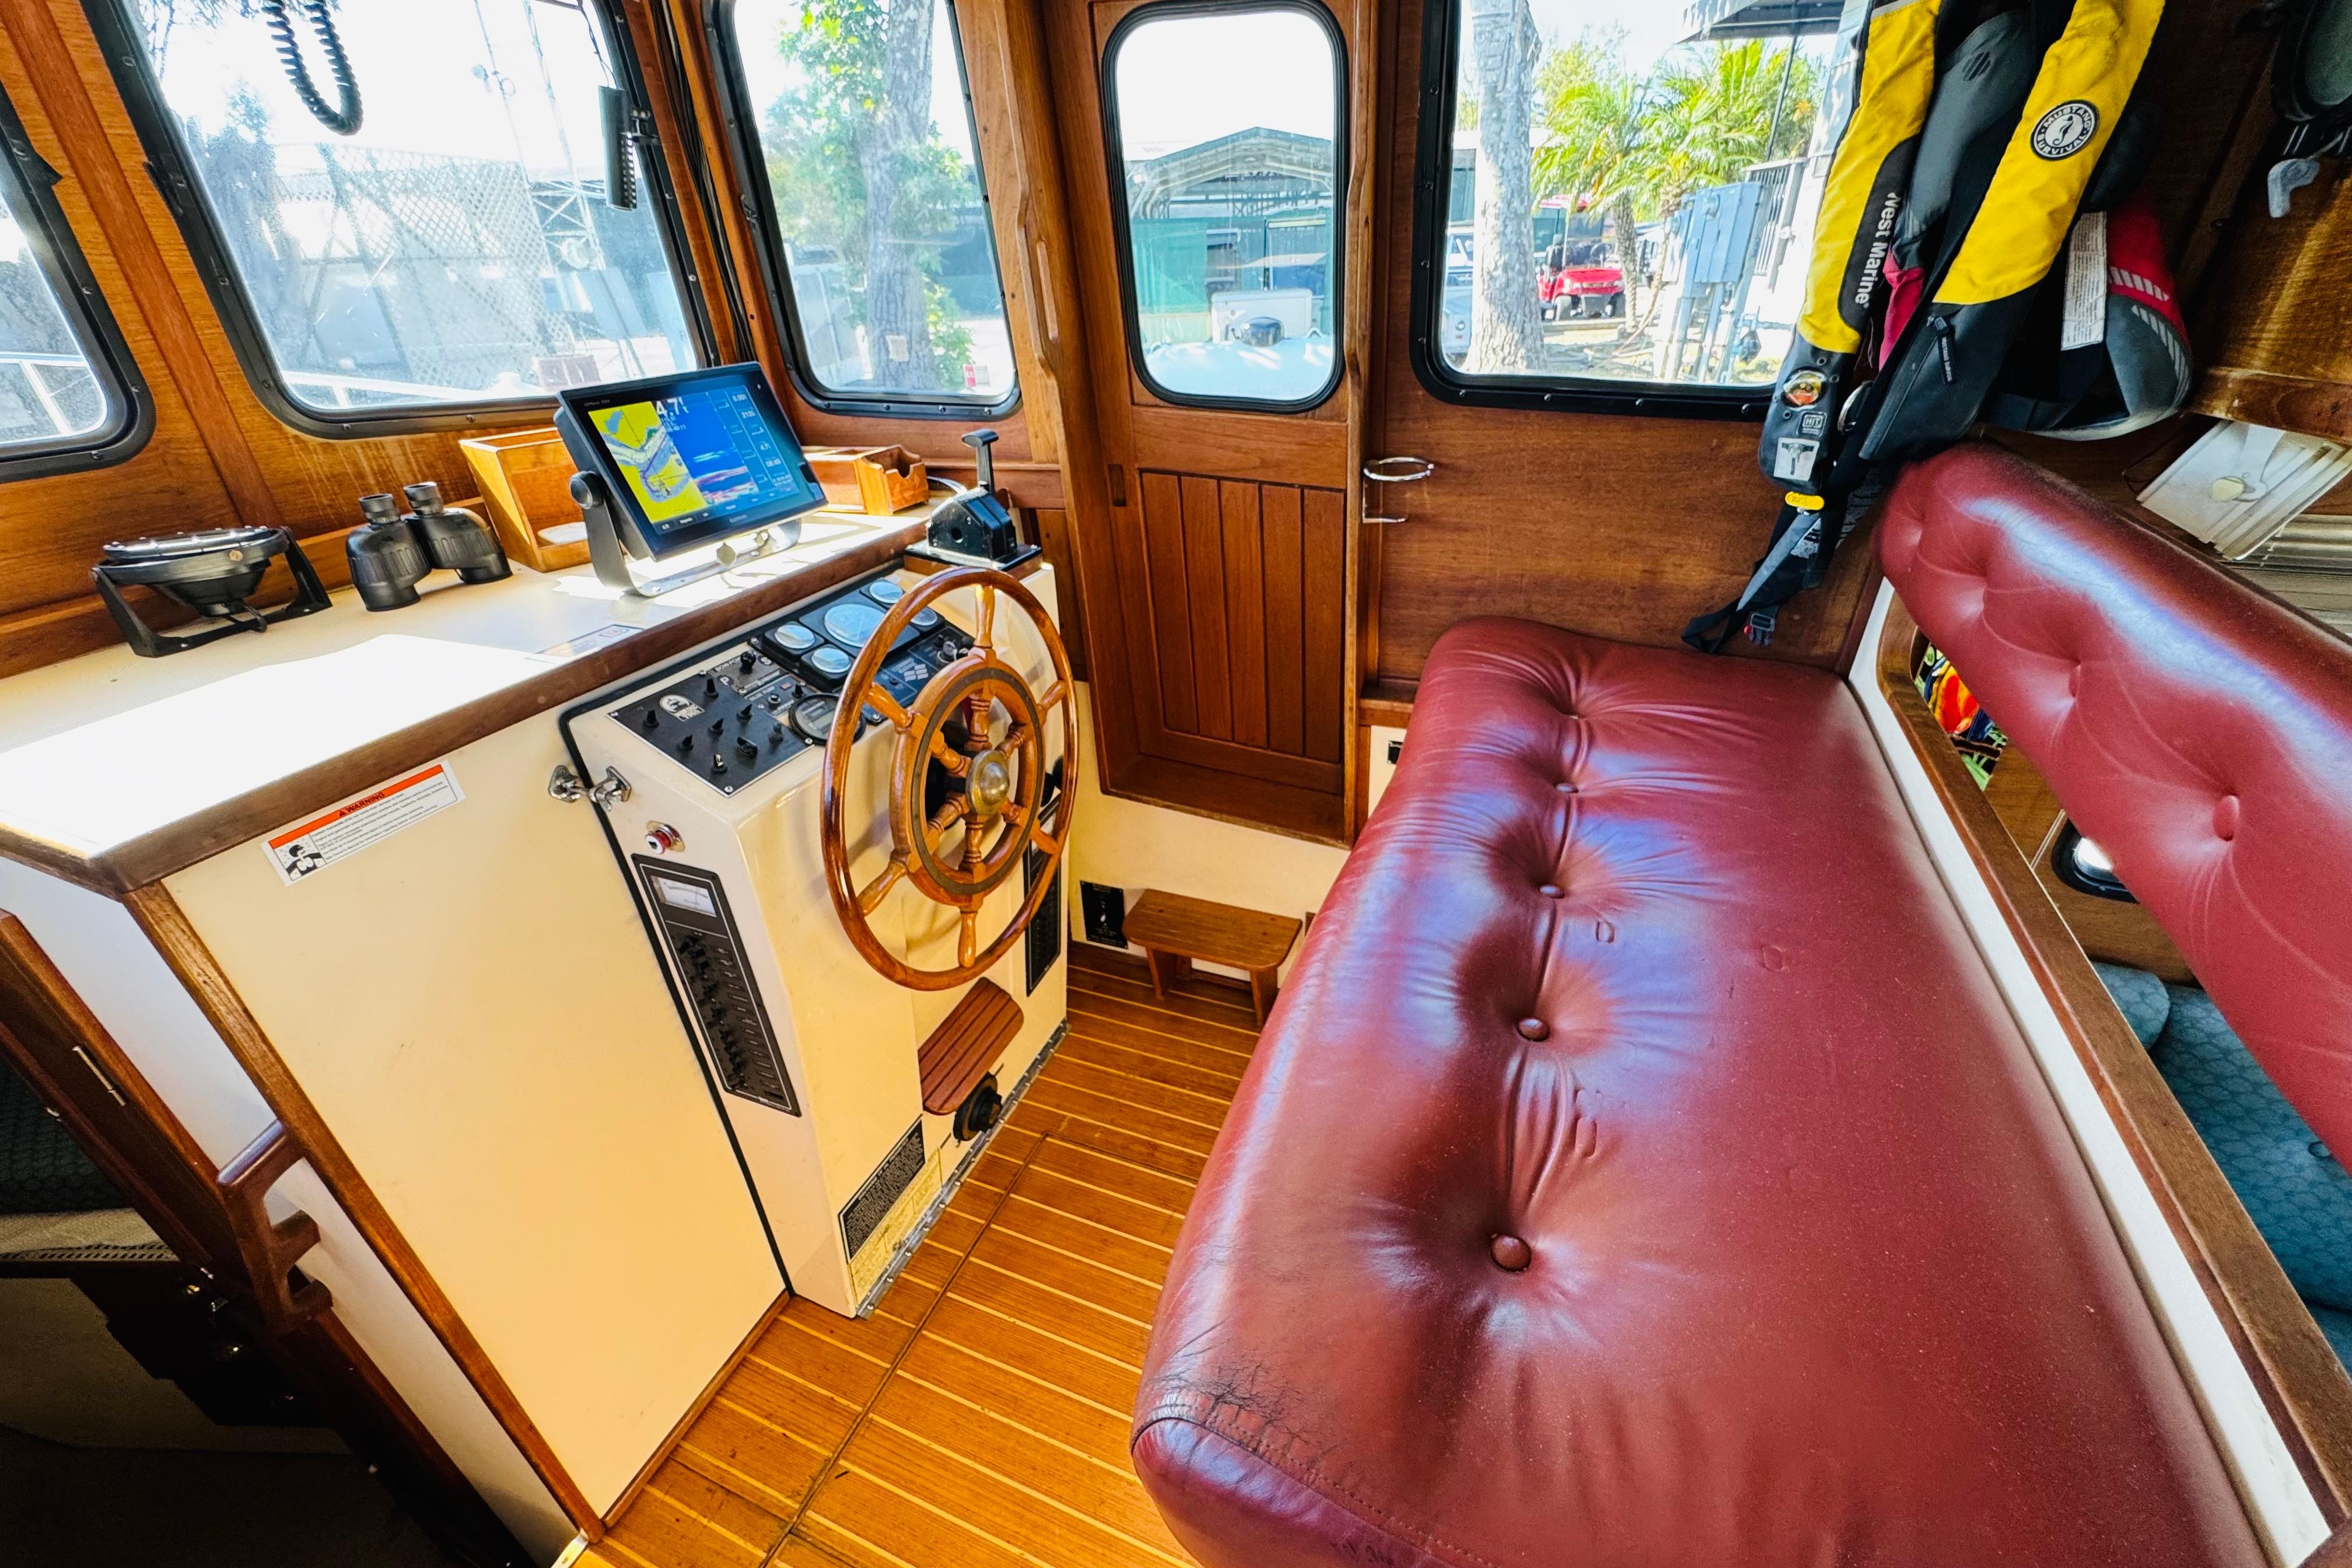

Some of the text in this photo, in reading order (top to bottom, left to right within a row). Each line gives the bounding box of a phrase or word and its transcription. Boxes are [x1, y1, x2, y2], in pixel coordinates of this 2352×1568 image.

[2043, 106, 2092, 128] MUSTANG
[2037, 134, 2087, 155] SURVIVAL
[761, 657, 772, 665] S
[345, 792, 385, 812] WARNING
